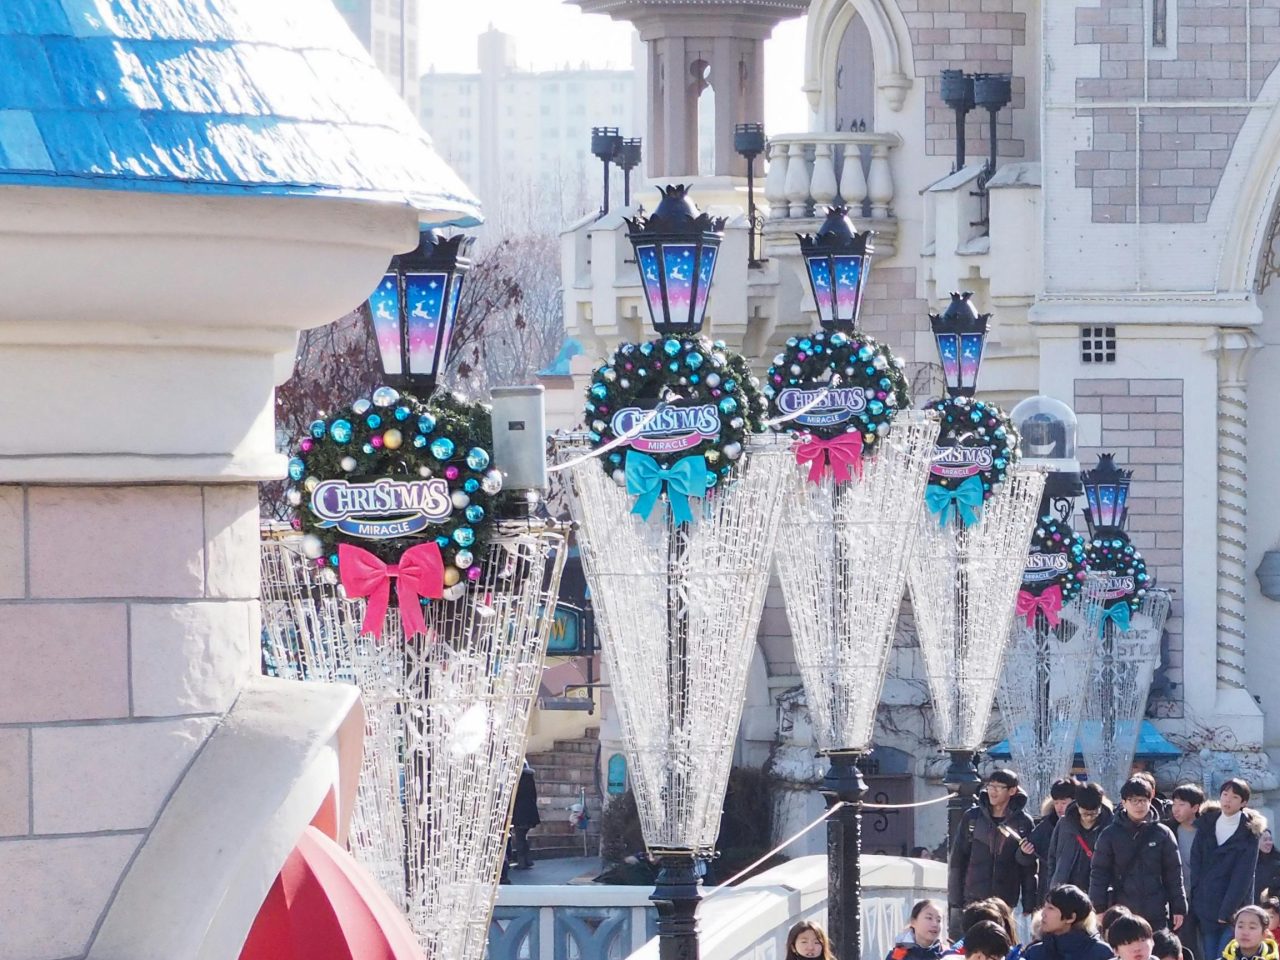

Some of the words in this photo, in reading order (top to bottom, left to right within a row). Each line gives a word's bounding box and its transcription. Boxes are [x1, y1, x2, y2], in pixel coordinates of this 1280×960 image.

[615, 407, 717, 436] CHRISTMAS
[806, 414, 839, 424] MIRACLE
[648, 438, 688, 451] MIRACLE
[929, 447, 991, 467] RISTMAS
[315, 479, 449, 518] CHRISTMAS
[358, 521, 410, 536] MIRACLE
[1025, 553, 1068, 570] RISTMAS
